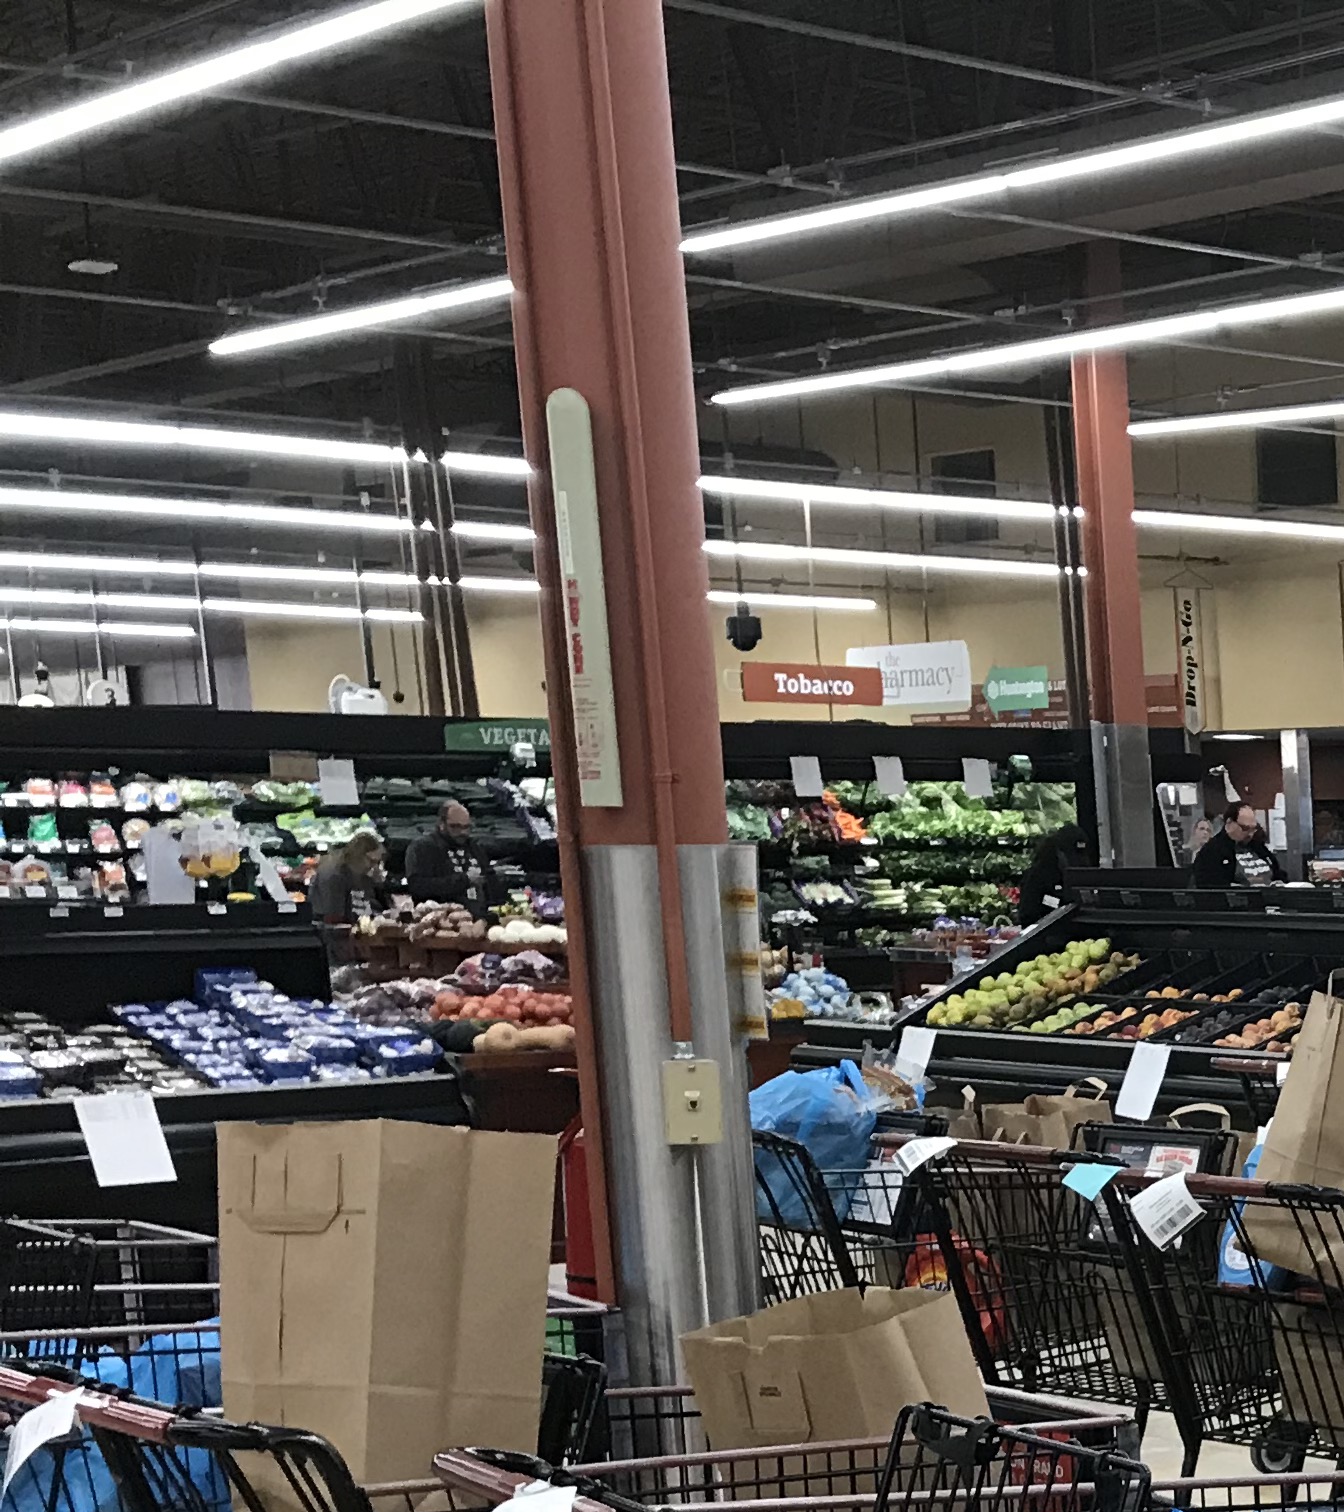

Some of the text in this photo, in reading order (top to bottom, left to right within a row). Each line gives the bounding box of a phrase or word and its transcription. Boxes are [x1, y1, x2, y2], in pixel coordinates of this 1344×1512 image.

[1181, 600, 1198, 708] Drop-N-Go
[774, 672, 854, 696] Tobacco
[878, 661, 955, 695] harmacy
